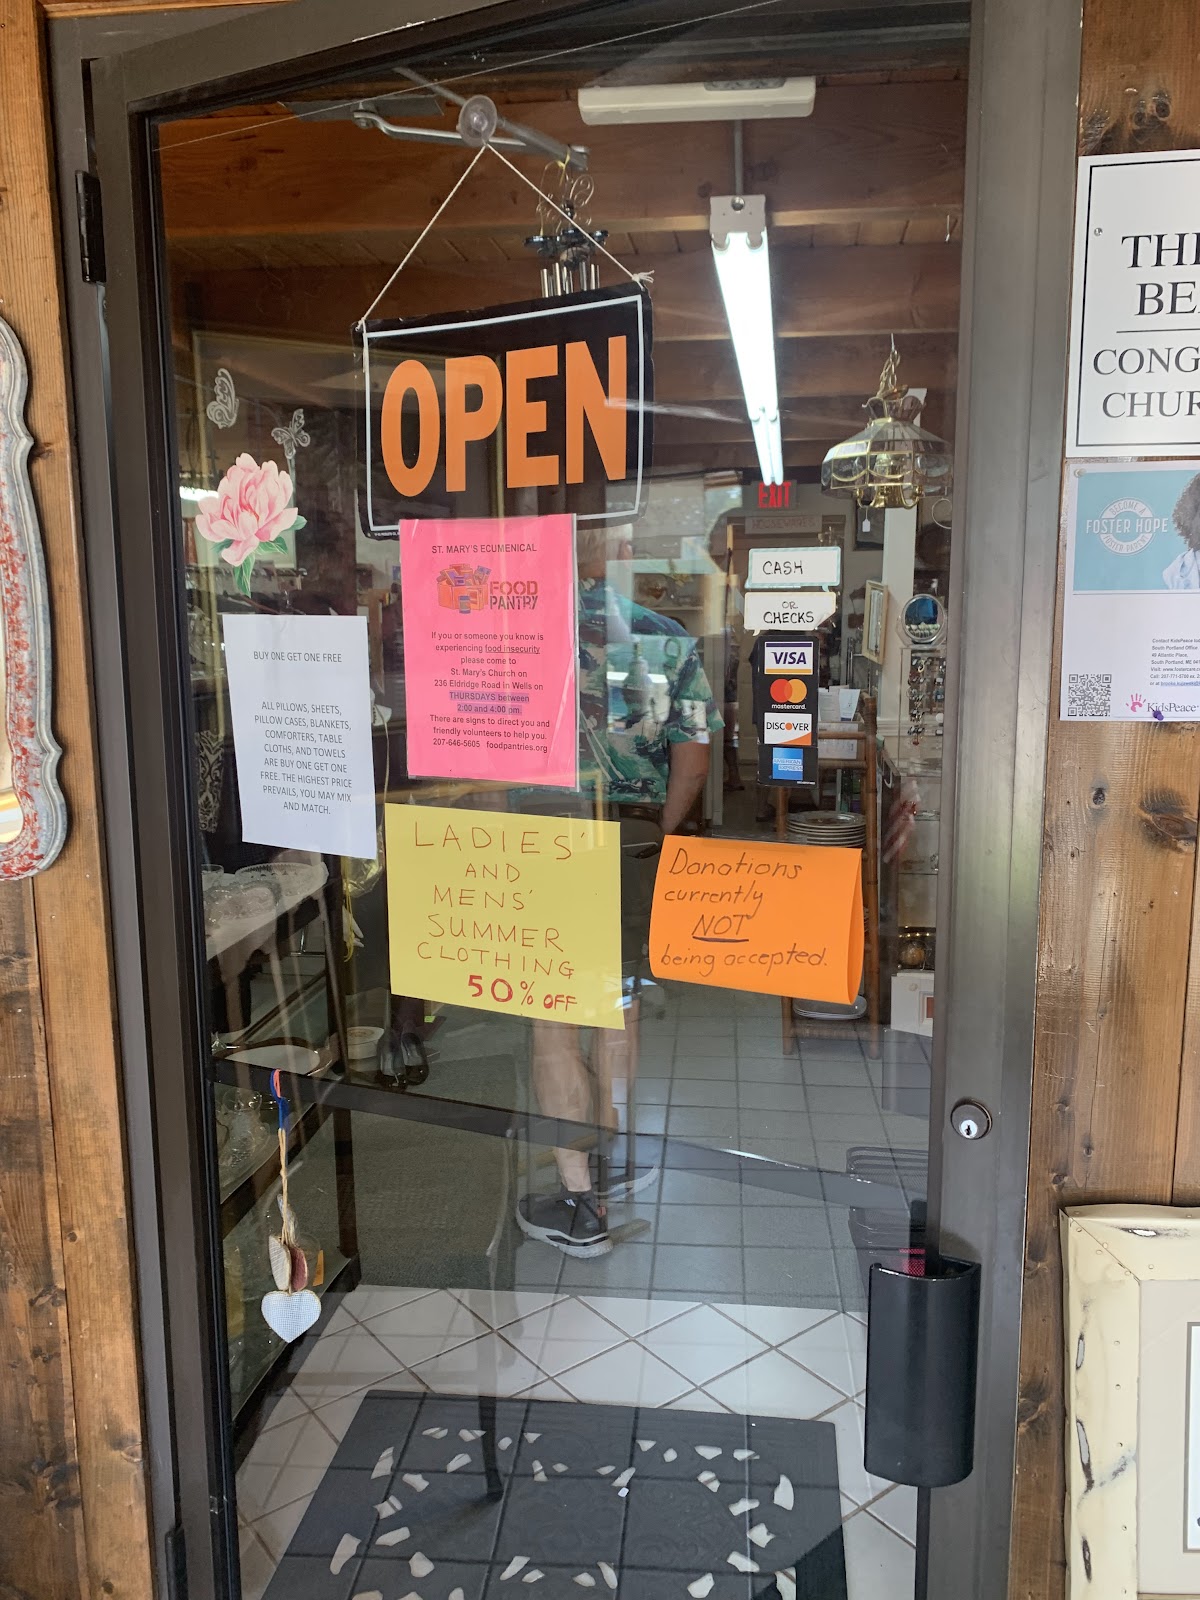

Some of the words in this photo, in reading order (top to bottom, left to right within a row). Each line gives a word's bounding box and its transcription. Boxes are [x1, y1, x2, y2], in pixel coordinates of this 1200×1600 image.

[1134, 281, 1200, 316] BE
[1093, 346, 1200, 375] CONG
[381, 335, 626, 497] OPEN
[758, 481, 791, 508] EXIT
[1109, 501, 1139, 515] BECOME
[1086, 519, 1131, 534] FOSTER
[1136, 518, 1168, 533] HOPE
[432, 545, 443, 553] ST.
[447, 545, 478, 553] MARY'S
[481, 544, 537, 552] ECUMENICAL
[1103, 534, 1123, 552] FOSTER
[1127, 535, 1148, 552] PARENT
[762, 560, 803, 575] CASH
[490, 581, 538, 595] FOOD
[490, 596, 538, 610] PANTRY
[782, 601, 798, 609] OR
[763, 611, 815, 624] CHECKS
[254, 651, 269, 659] BUY
[271, 652, 285, 660] ONE
[287, 653, 302, 661] GET
[304, 653, 320, 661] ONE
[323, 654, 342, 662] FREE
[436, 644, 482, 653] experiencing
[486, 645, 501, 653] food
[504, 645, 540, 654] insecurity
[771, 651, 807, 665] VISA
[463, 668, 486, 677] Mary's
[488, 669, 515, 677] Church
[450, 680, 479, 689] Eldridge
[512, 682, 532, 690] Wells
[450, 692, 495, 700] THURSDAYS
[498, 694, 529, 702] between
[262, 701, 274, 710] ALL
[276, 702, 309, 714] PILLOWS,
[311, 704, 342, 716] SHEETS,
[457, 704, 472, 712] 2:00
[474, 705, 487, 713] and
[1147, 703, 1196, 712] KidsPeace
[254, 715, 282, 724] PILLOW
[285, 717, 308, 728] CASES,
[310, 719, 351, 731] BLANKETS,
[430, 714, 450, 722] There
[466, 717, 485, 725] signs
[766, 722, 809, 731] DISCOVER
[265, 730, 316, 743] COMFORTERS,
[318, 734, 342, 744] TABLE
[434, 727, 461, 736] friendly
[463, 729, 501, 737] volunteers
[514, 731, 529, 739] help
[264, 744, 293, 755] CLOTHS,
[296, 746, 311, 755] AND
[313, 748, 345, 758] TOWELS
[433, 738, 480, 747] 207-646-5605
[487, 741, 547, 753] foodpantries.org
[264, 758, 278, 767] ARE
[281, 759, 294, 768] BUY
[296, 761, 312, 770] ONE
[314, 762, 329, 771] GET
[331, 763, 347, 773] ONE
[260, 771, 280, 780] FREE.
[282, 773, 295, 782] THE
[298, 775, 329, 785] HIGHEST
[332, 778, 352, 788] PRICE
[263, 785, 298, 797] PREVAILS,
[300, 789, 315, 798] YOU
[318, 791, 335, 800] MAY
[337, 793, 351, 802] MIX
[283, 801, 299, 811] AND
[302, 803, 331, 814] MATCH.
[415, 821, 585, 860] LADIES'
[669, 847, 802, 879] Donations
[465, 863, 521, 883] AND
[433, 884, 533, 910] MENS'
[664, 880, 764, 919] currently
[691, 914, 749, 936] NOT
[428, 914, 564, 952] SUMMER
[417, 941, 575, 979] CLOTHING
[661, 943, 715, 977] being
[724, 942, 828, 976] accepted.
[467, 974, 535, 1006] 50%
[543, 994, 578, 1012] OFF
